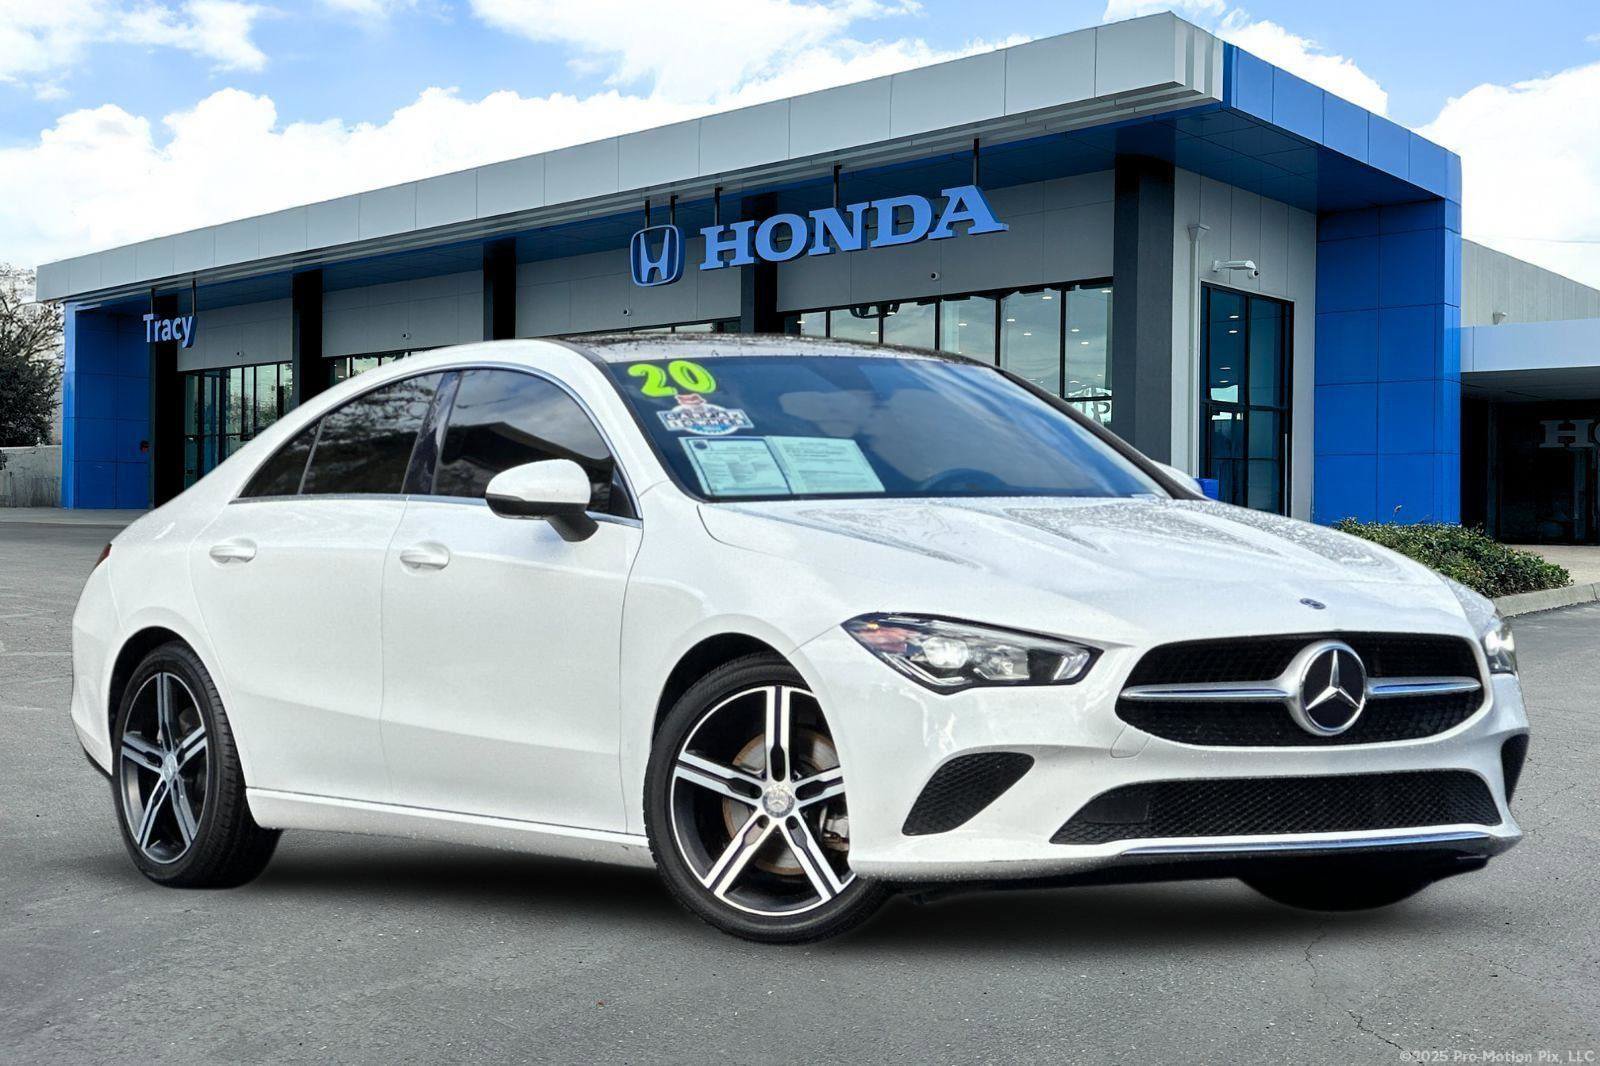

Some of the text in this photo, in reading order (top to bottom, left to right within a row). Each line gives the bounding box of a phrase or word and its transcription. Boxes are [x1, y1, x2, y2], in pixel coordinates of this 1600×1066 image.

[700, 184, 1009, 271] HONDA
[143, 313, 194, 348] Tracy
[628, 360, 717, 398] 20
[1538, 418, 1600, 449] H
